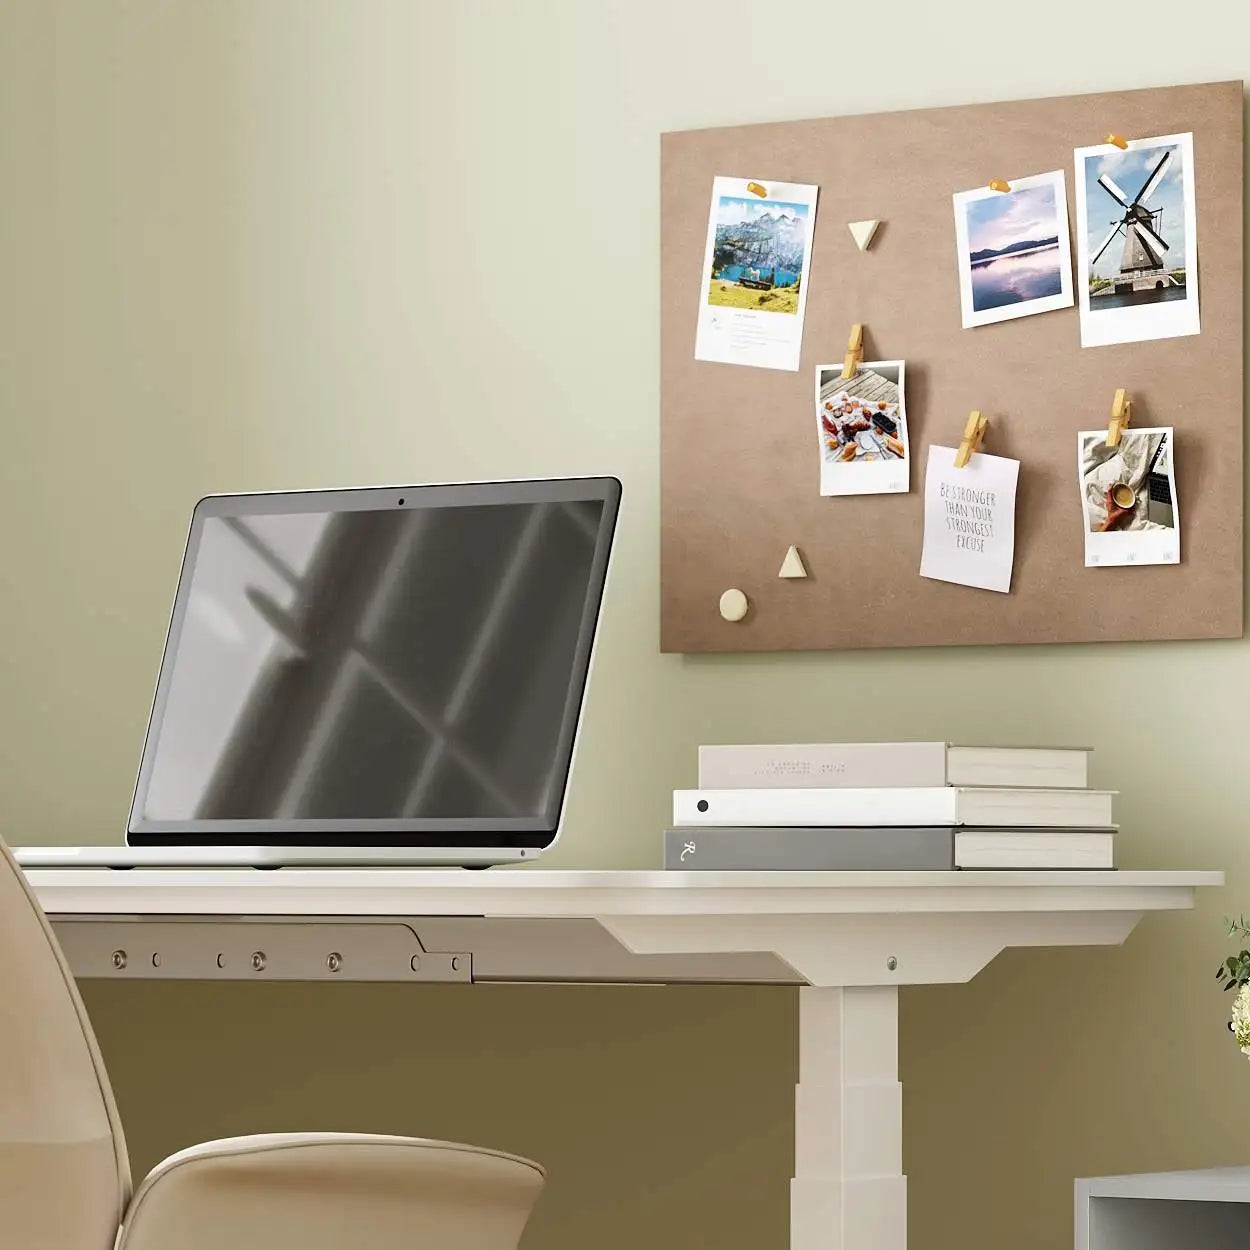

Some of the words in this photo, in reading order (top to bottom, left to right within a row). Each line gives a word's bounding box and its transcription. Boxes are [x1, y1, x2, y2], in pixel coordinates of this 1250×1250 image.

[940, 482, 950, 498] BE
[951, 485, 996, 506] STRONGER
[944, 500, 968, 518] THAN
[970, 506, 993, 521] YOUR
[946, 517, 994, 538] STRONGEST
[956, 535, 985, 553] EXCUSE
